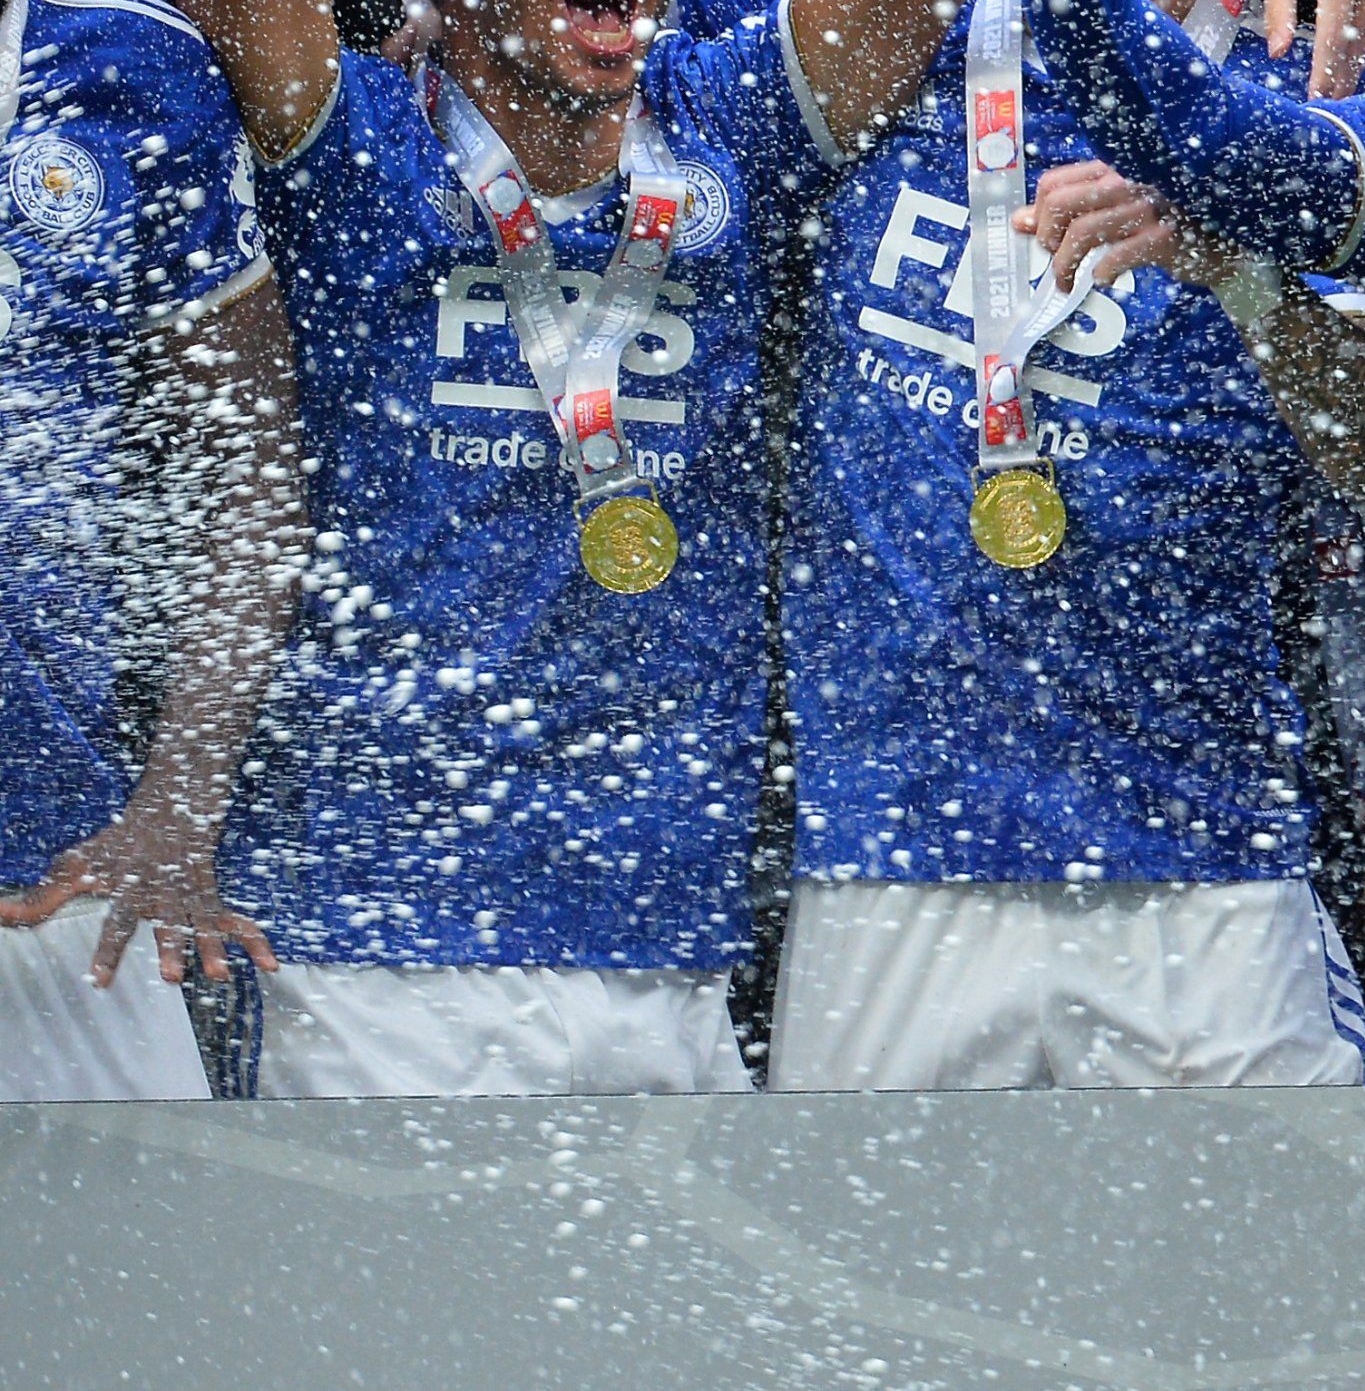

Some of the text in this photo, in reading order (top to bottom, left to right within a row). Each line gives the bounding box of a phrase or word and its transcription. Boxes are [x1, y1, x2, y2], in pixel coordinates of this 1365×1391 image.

[74, 191, 95, 219] CUB
[986, 204, 1009, 318] 2021 WINNER
[854, 347, 953, 416] trade
[428, 426, 547, 470] trade
